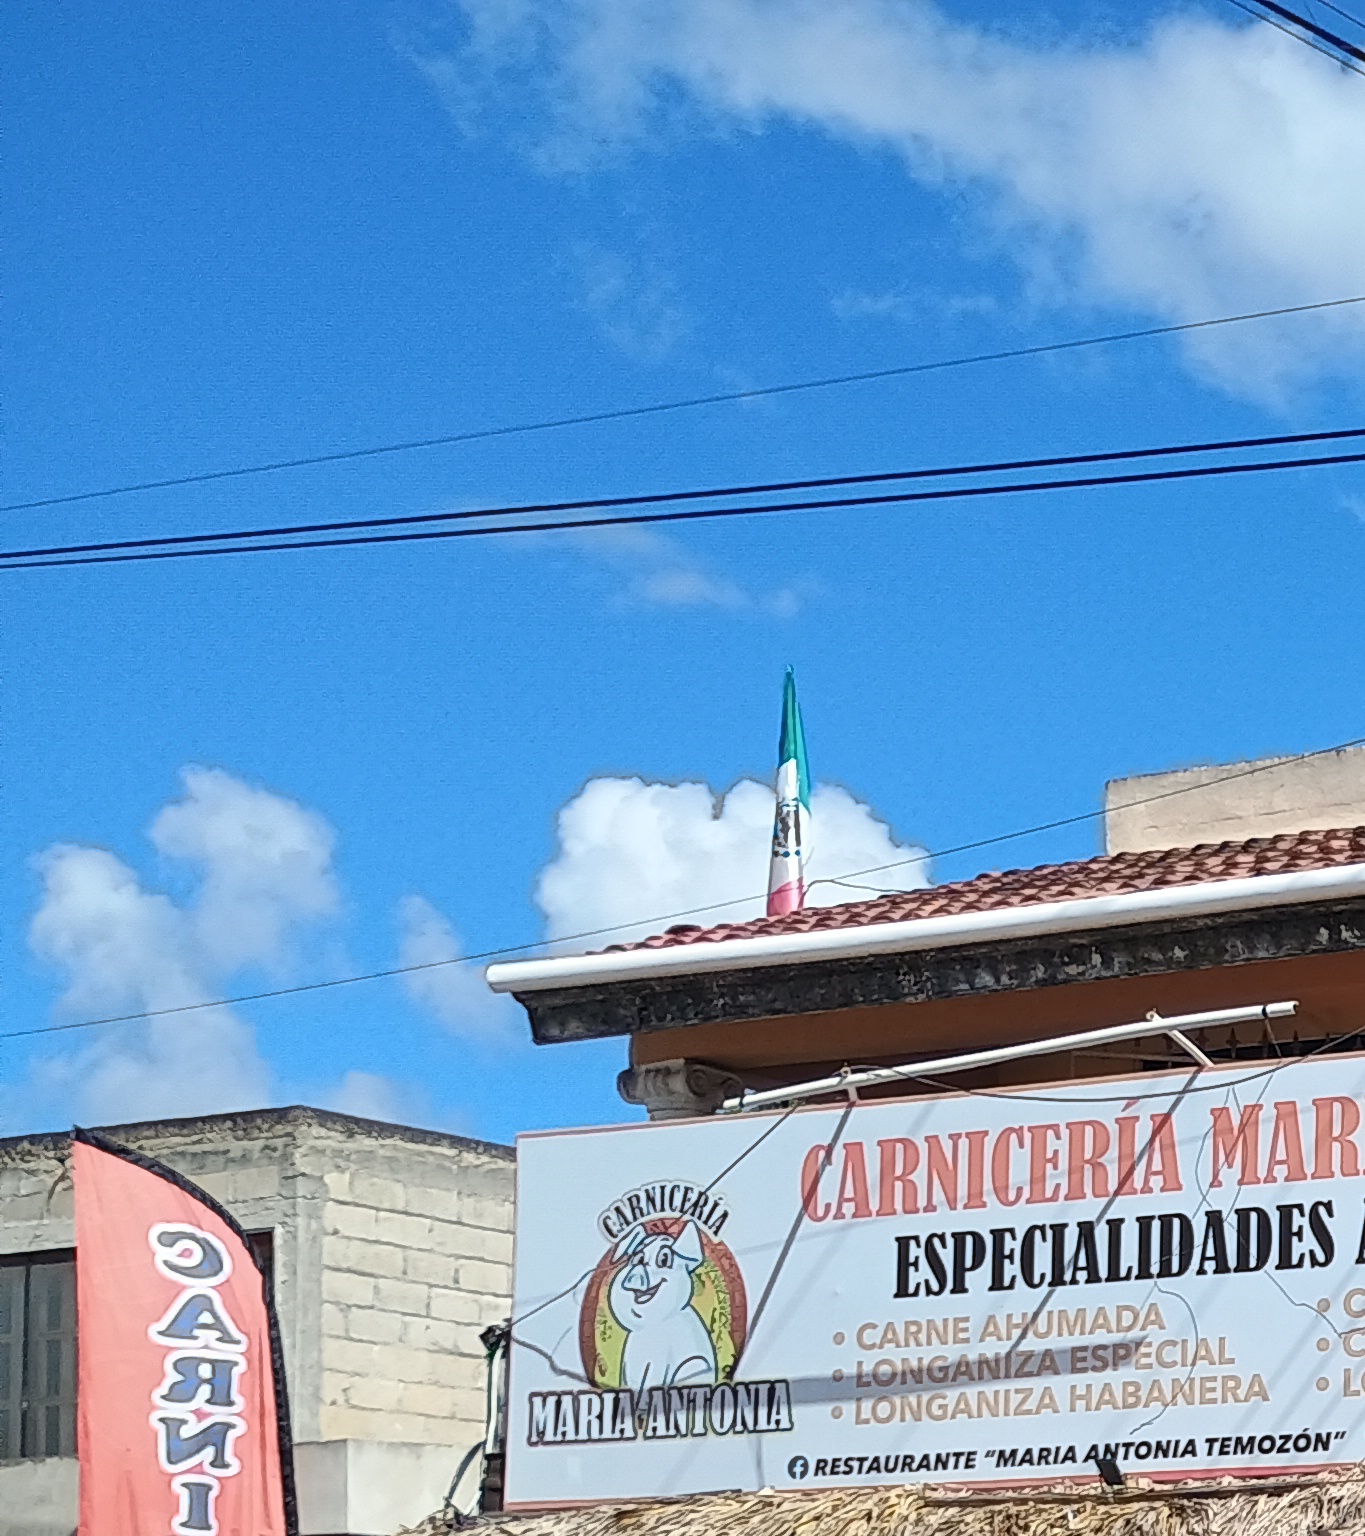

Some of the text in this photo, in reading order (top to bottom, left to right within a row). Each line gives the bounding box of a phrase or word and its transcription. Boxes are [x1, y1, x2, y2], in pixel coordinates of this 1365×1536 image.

[802, 1100, 1183, 1223] CARNICERÍA
[601, 1183, 731, 1239] CARNICERÍA
[893, 1201, 1335, 1300] ESPECIALIDADES
[855, 1301, 1167, 1351] CARNE AHUMADA
[853, 1336, 1237, 1389] LONGANIZA ESPECIAL
[528, 1379, 794, 1446] MARIA ANTONIA
[853, 1373, 1270, 1426] LONGANIZA HABANERA
[813, 1449, 977, 1477] RESTAURANTE
[1081, 1440, 1197, 1464] ANTONIA
